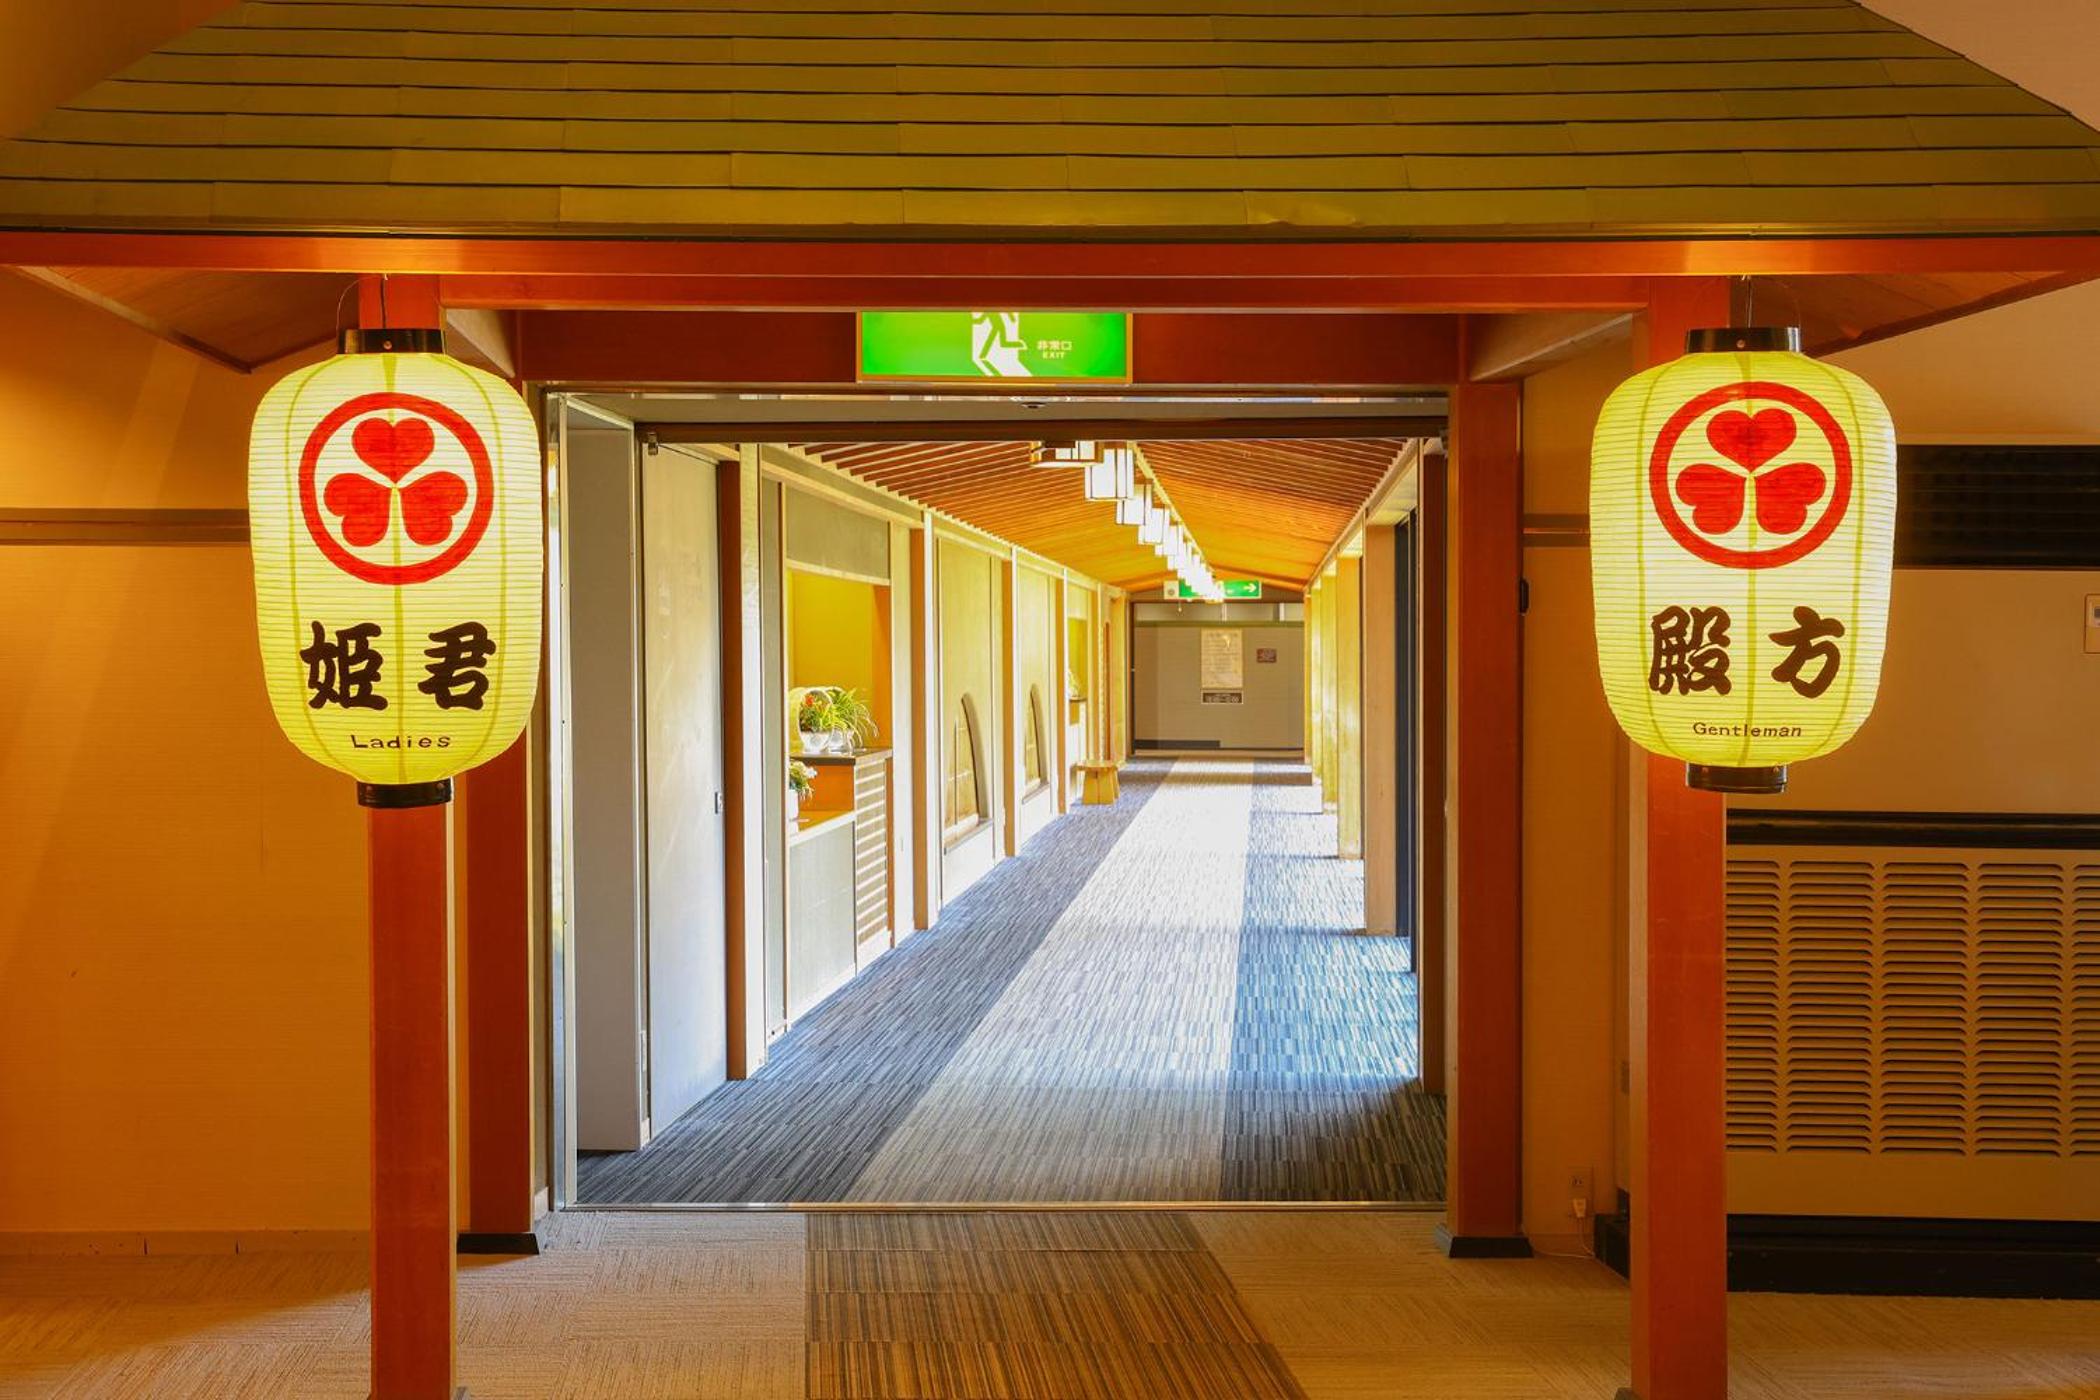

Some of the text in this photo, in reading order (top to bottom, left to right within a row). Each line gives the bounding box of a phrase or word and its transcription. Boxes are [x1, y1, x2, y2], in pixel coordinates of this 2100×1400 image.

[1043, 351, 1065, 359] EXIT
[1648, 605, 1845, 698] 殿方
[300, 621, 496, 710] 姫君
[1693, 722, 1801, 737] Gentleman
[351, 735, 451, 748] Ladies
